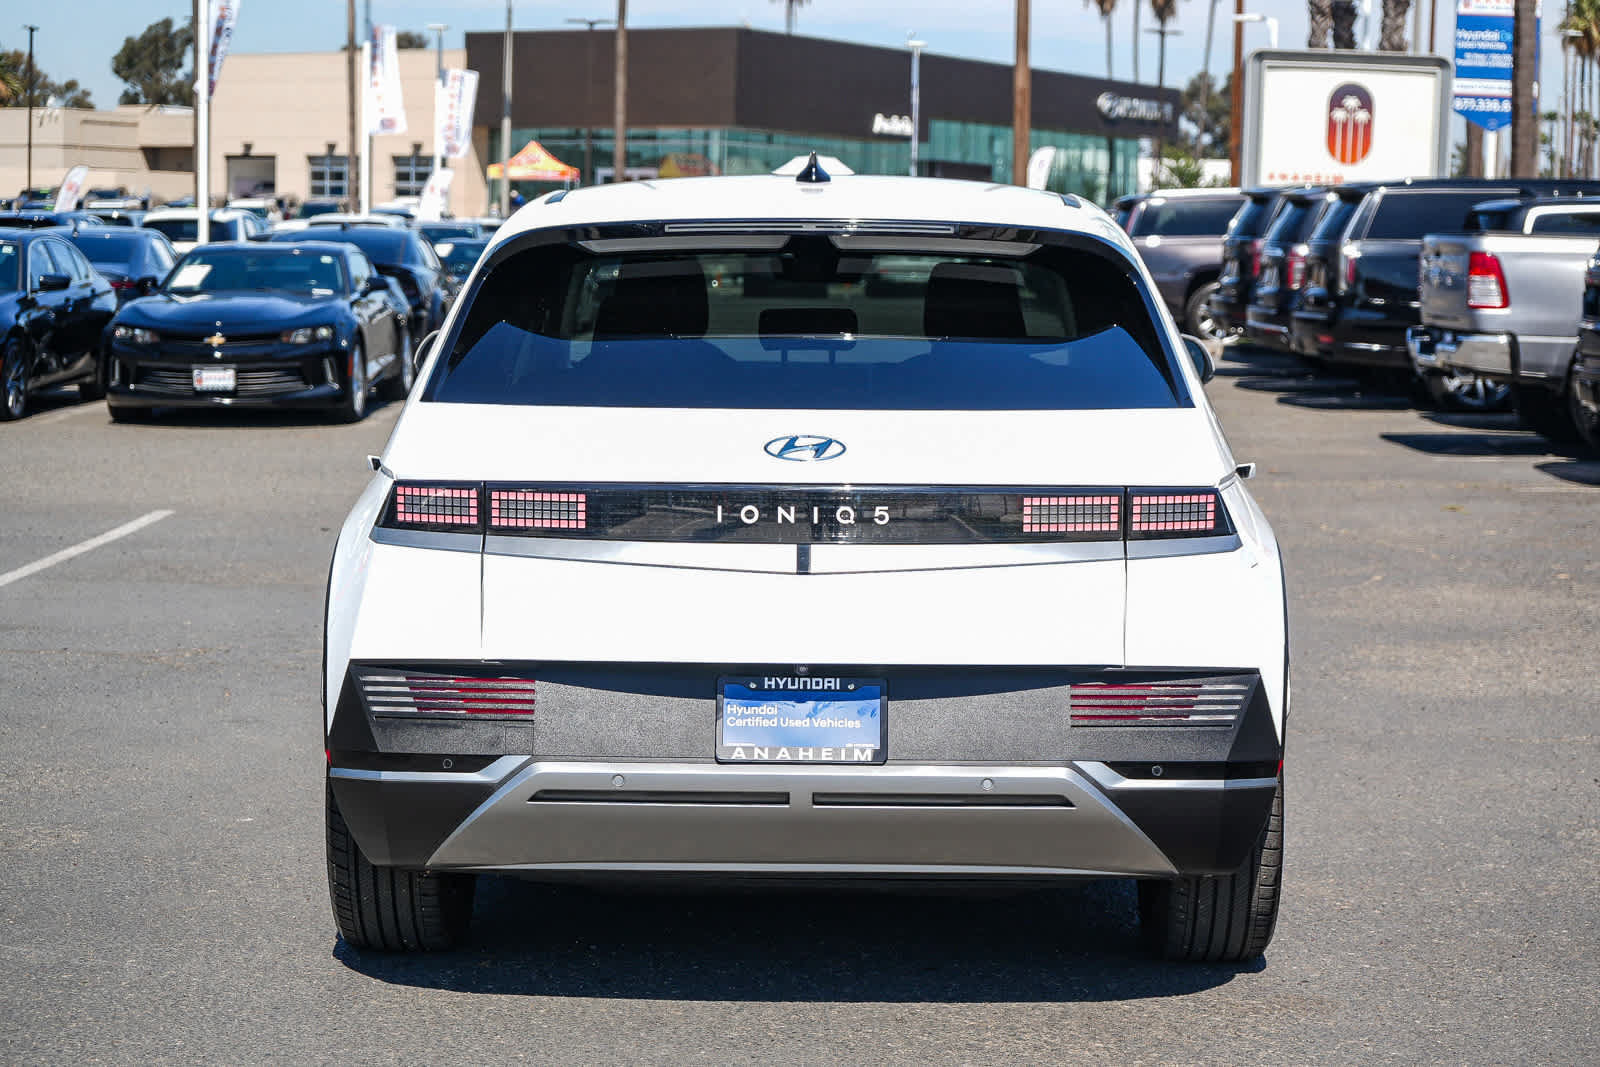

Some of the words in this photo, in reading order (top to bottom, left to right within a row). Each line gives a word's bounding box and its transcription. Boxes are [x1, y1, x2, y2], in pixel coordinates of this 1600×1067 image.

[1456, 29, 1500, 41] Hyundai
[717, 504, 856, 525] IONIQ
[873, 506, 890, 525] 5
[764, 677, 840, 690] HYUNDAI
[727, 703, 778, 715] Hyundai
[726, 716, 777, 728] Certified
[780, 717, 810, 728] Used
[812, 718, 861, 729] Vehicles
[731, 747, 873, 761] ANAHEIM
